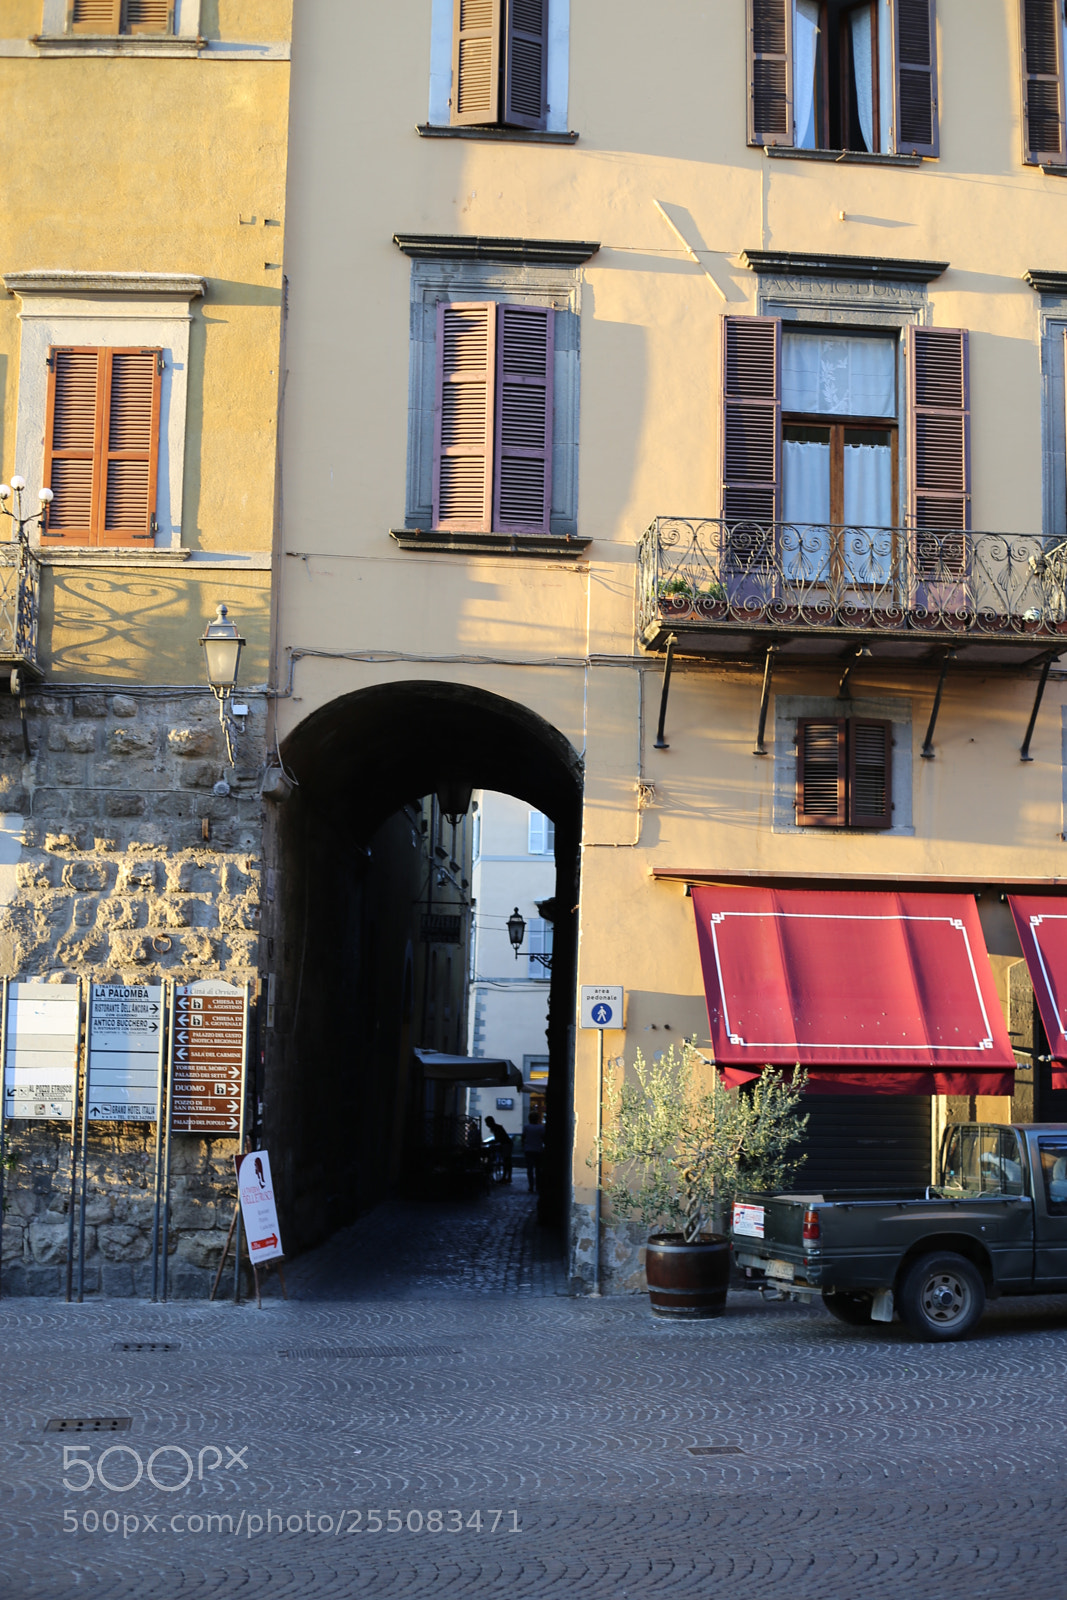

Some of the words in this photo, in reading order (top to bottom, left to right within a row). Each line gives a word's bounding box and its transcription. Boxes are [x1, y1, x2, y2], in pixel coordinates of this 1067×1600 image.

[95, 989, 105, 997] LA
[108, 989, 149, 998] PALOMBA
[93, 1019, 116, 1027] ANTICO
[116, 1019, 148, 1028] BUCCHERO
[174, 1084, 205, 1092] DUOMO
